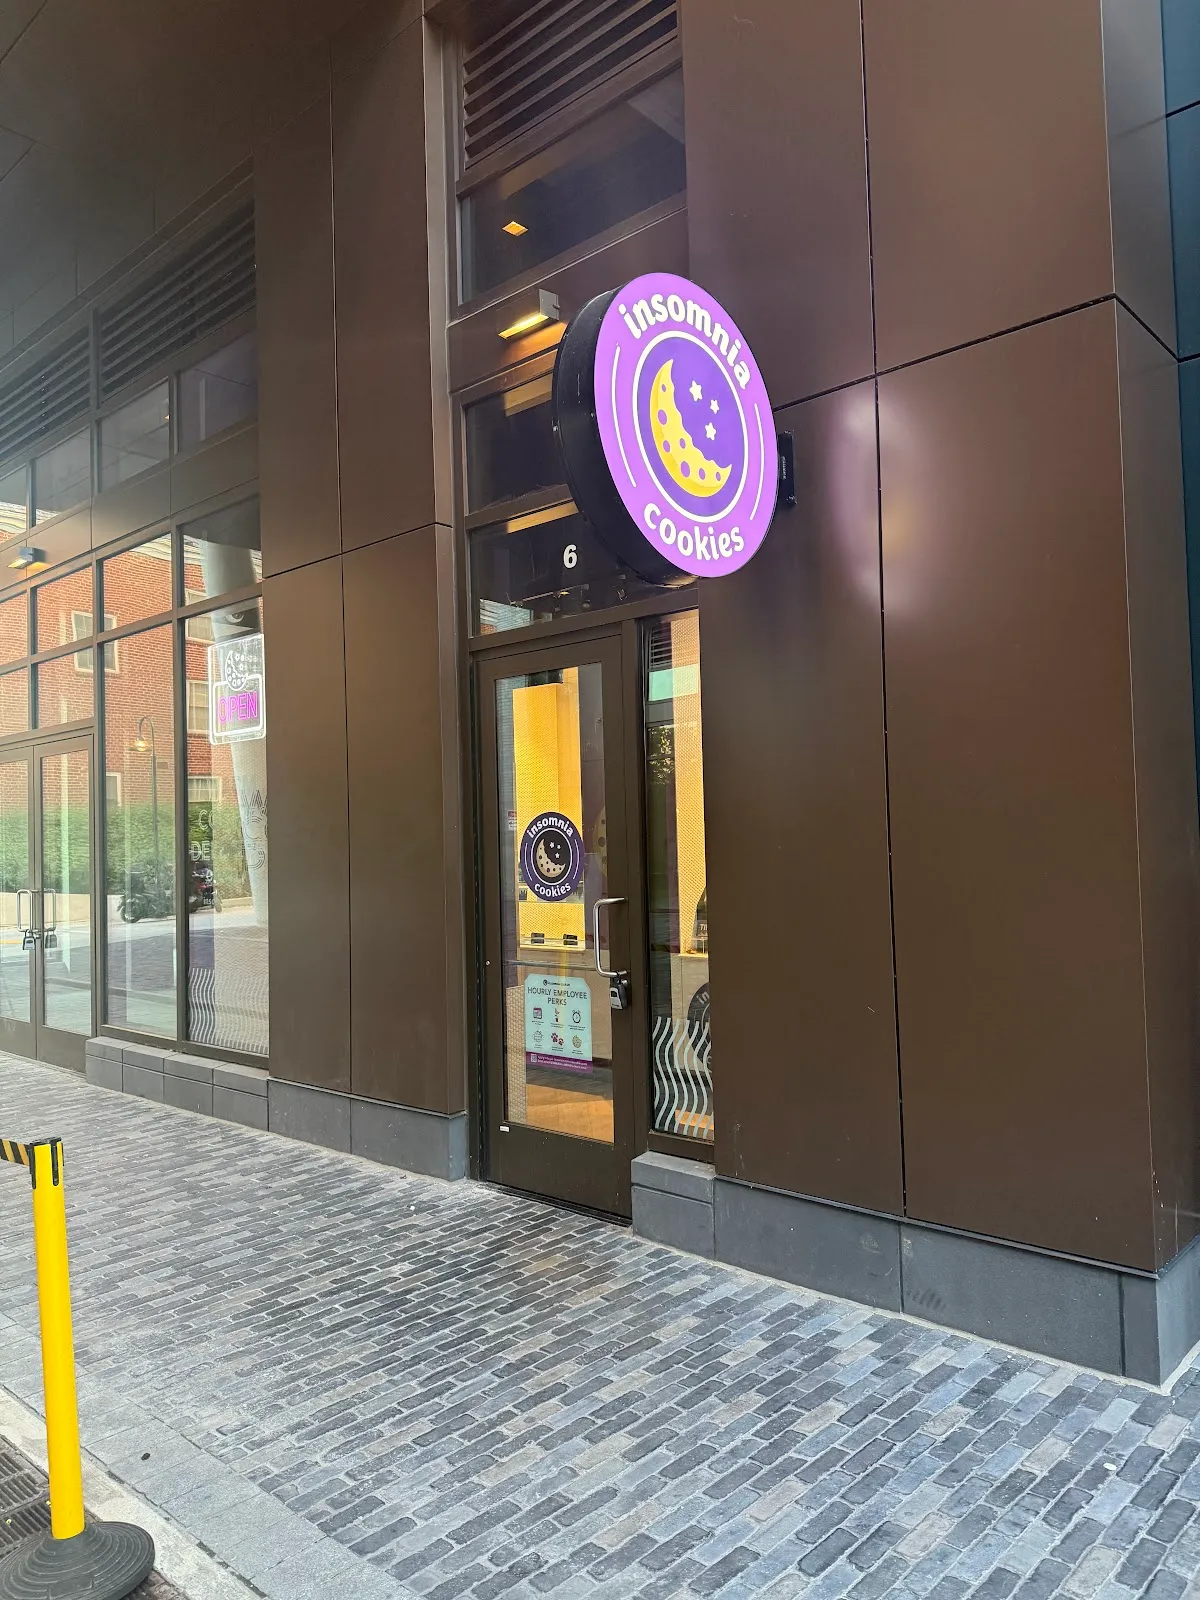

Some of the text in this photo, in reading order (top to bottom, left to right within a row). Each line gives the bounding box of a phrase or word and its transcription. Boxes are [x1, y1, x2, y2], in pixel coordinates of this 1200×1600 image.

[618, 293, 751, 390] insomnia
[644, 502, 745, 561] cookies
[563, 544, 578, 569] 6
[217, 690, 258, 725] OPEN
[526, 816, 574, 839] insomnia
[534, 882, 572, 898] cookies
[527, 986, 588, 1000] HOURLY EMPLOYEE
[547, 997, 567, 1006] PERKS
